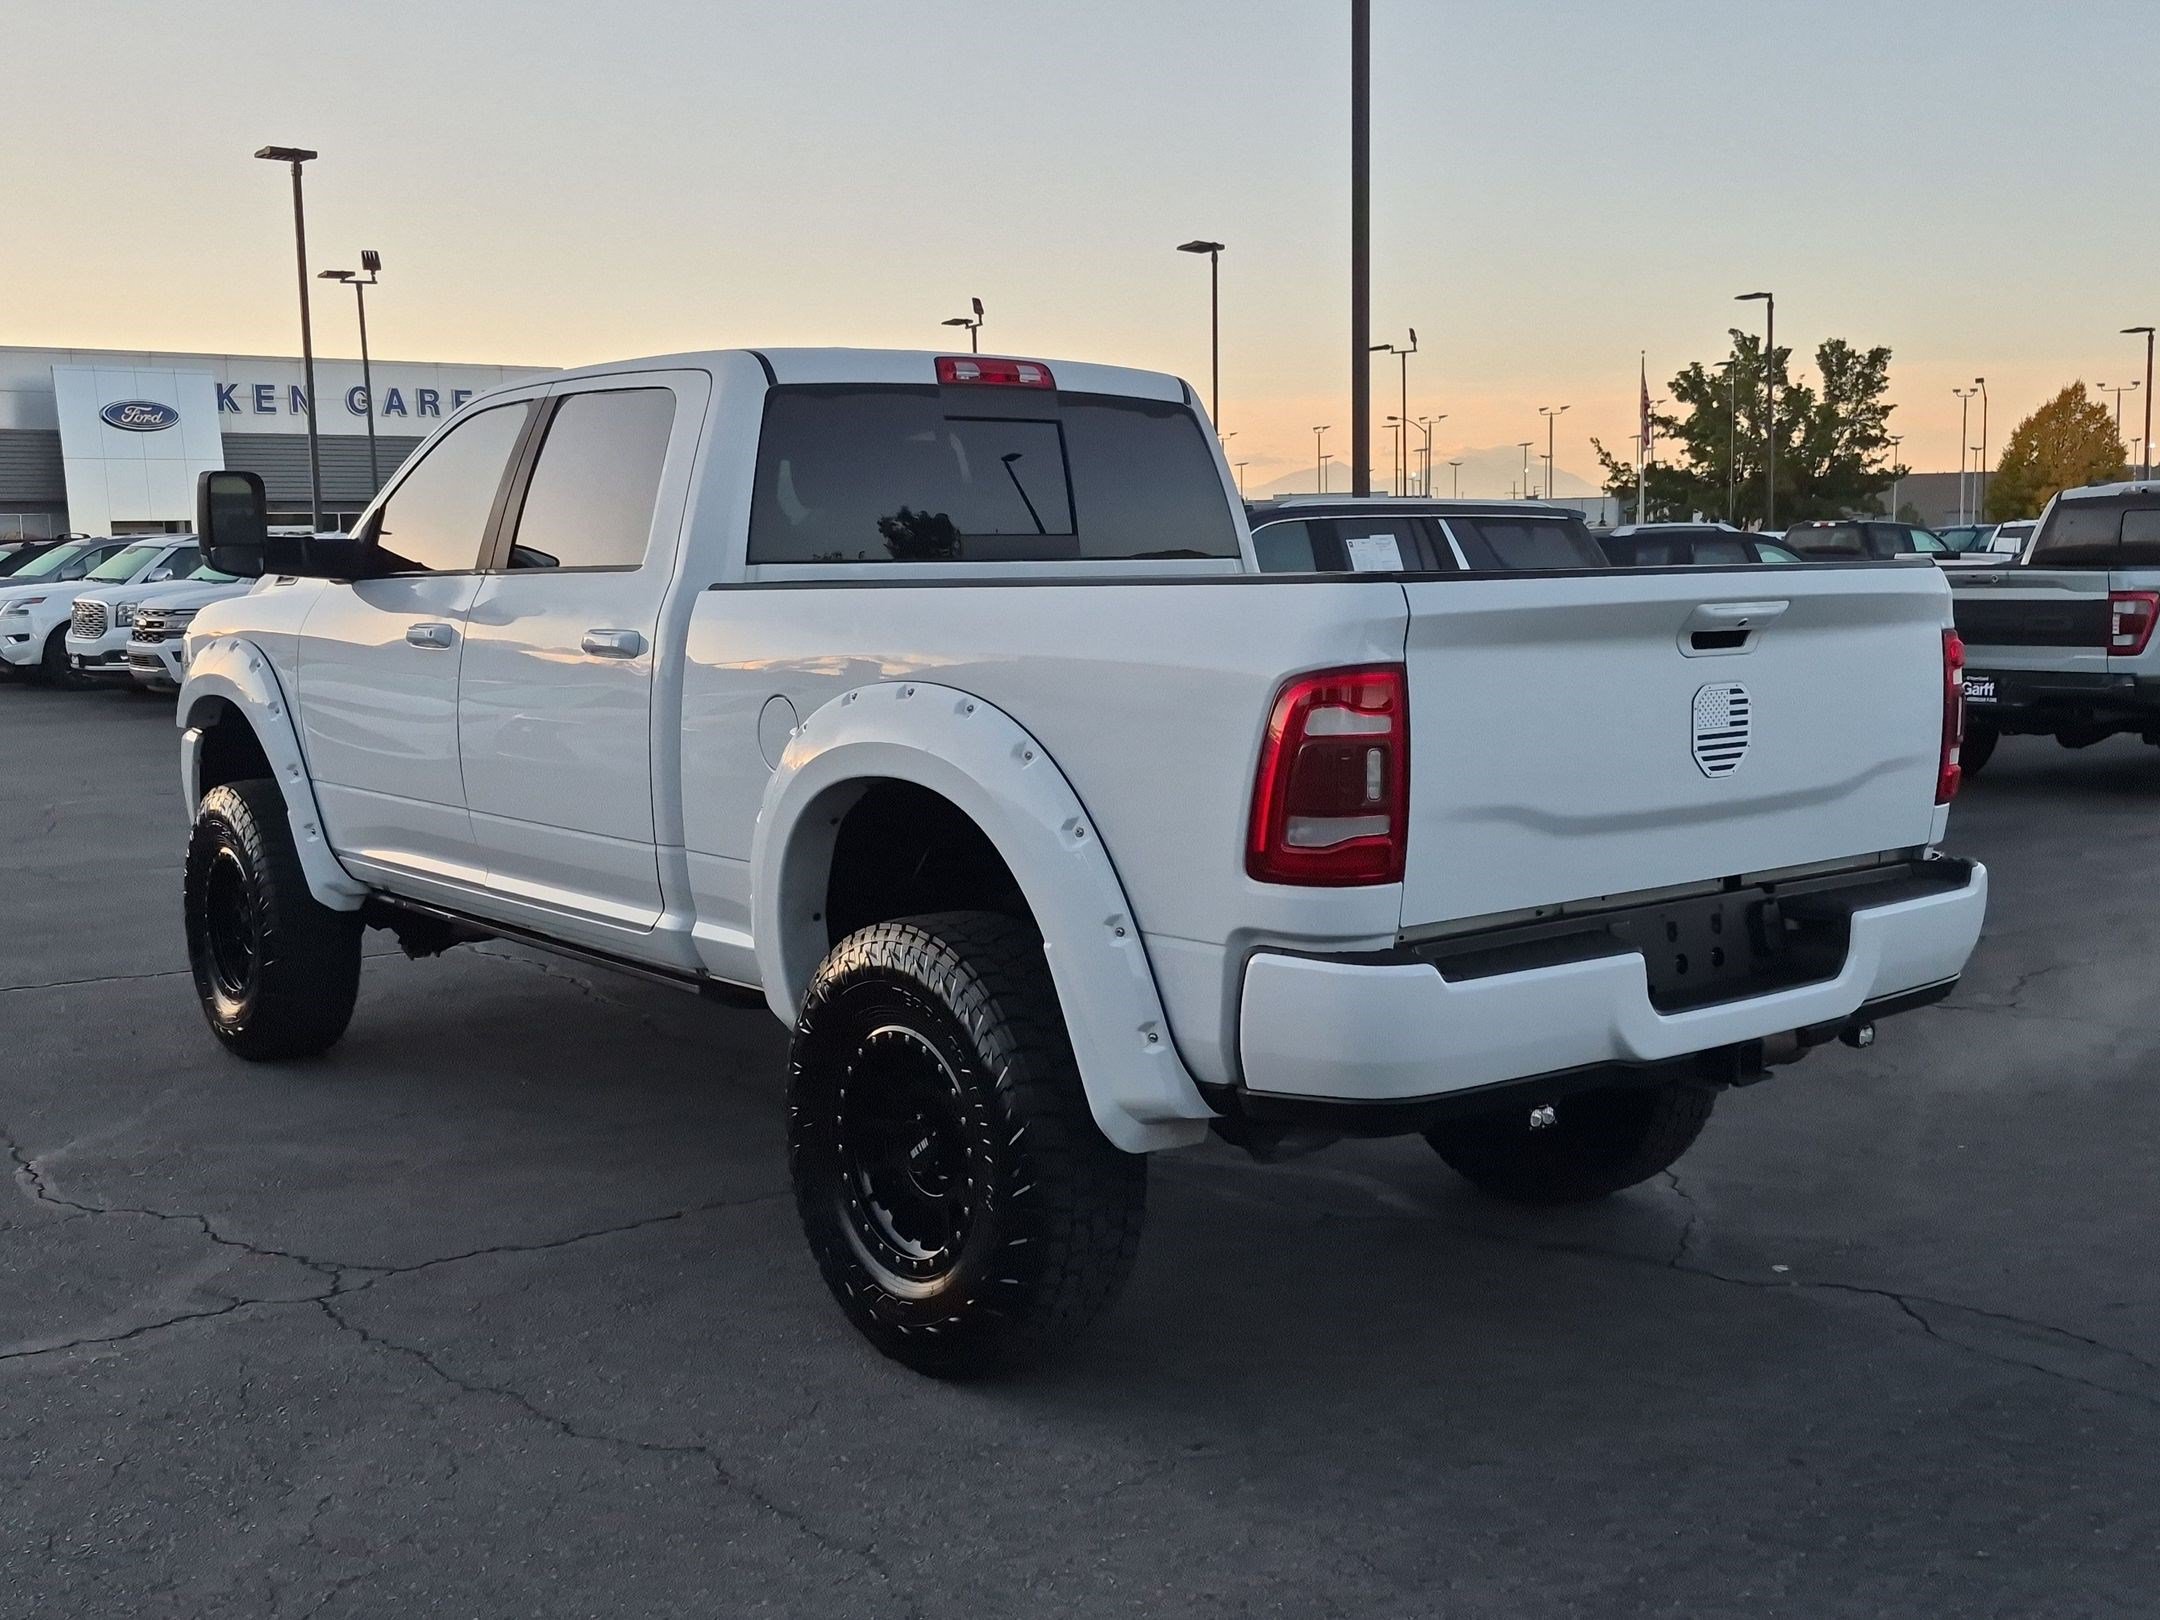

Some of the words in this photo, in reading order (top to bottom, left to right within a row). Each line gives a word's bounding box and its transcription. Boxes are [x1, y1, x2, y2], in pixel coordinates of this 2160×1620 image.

[216, 383, 310, 416] KEN
[345, 385, 480, 418] GARF
[121, 405, 163, 423] Ford
[1961, 681, 1995, 696] Garff
